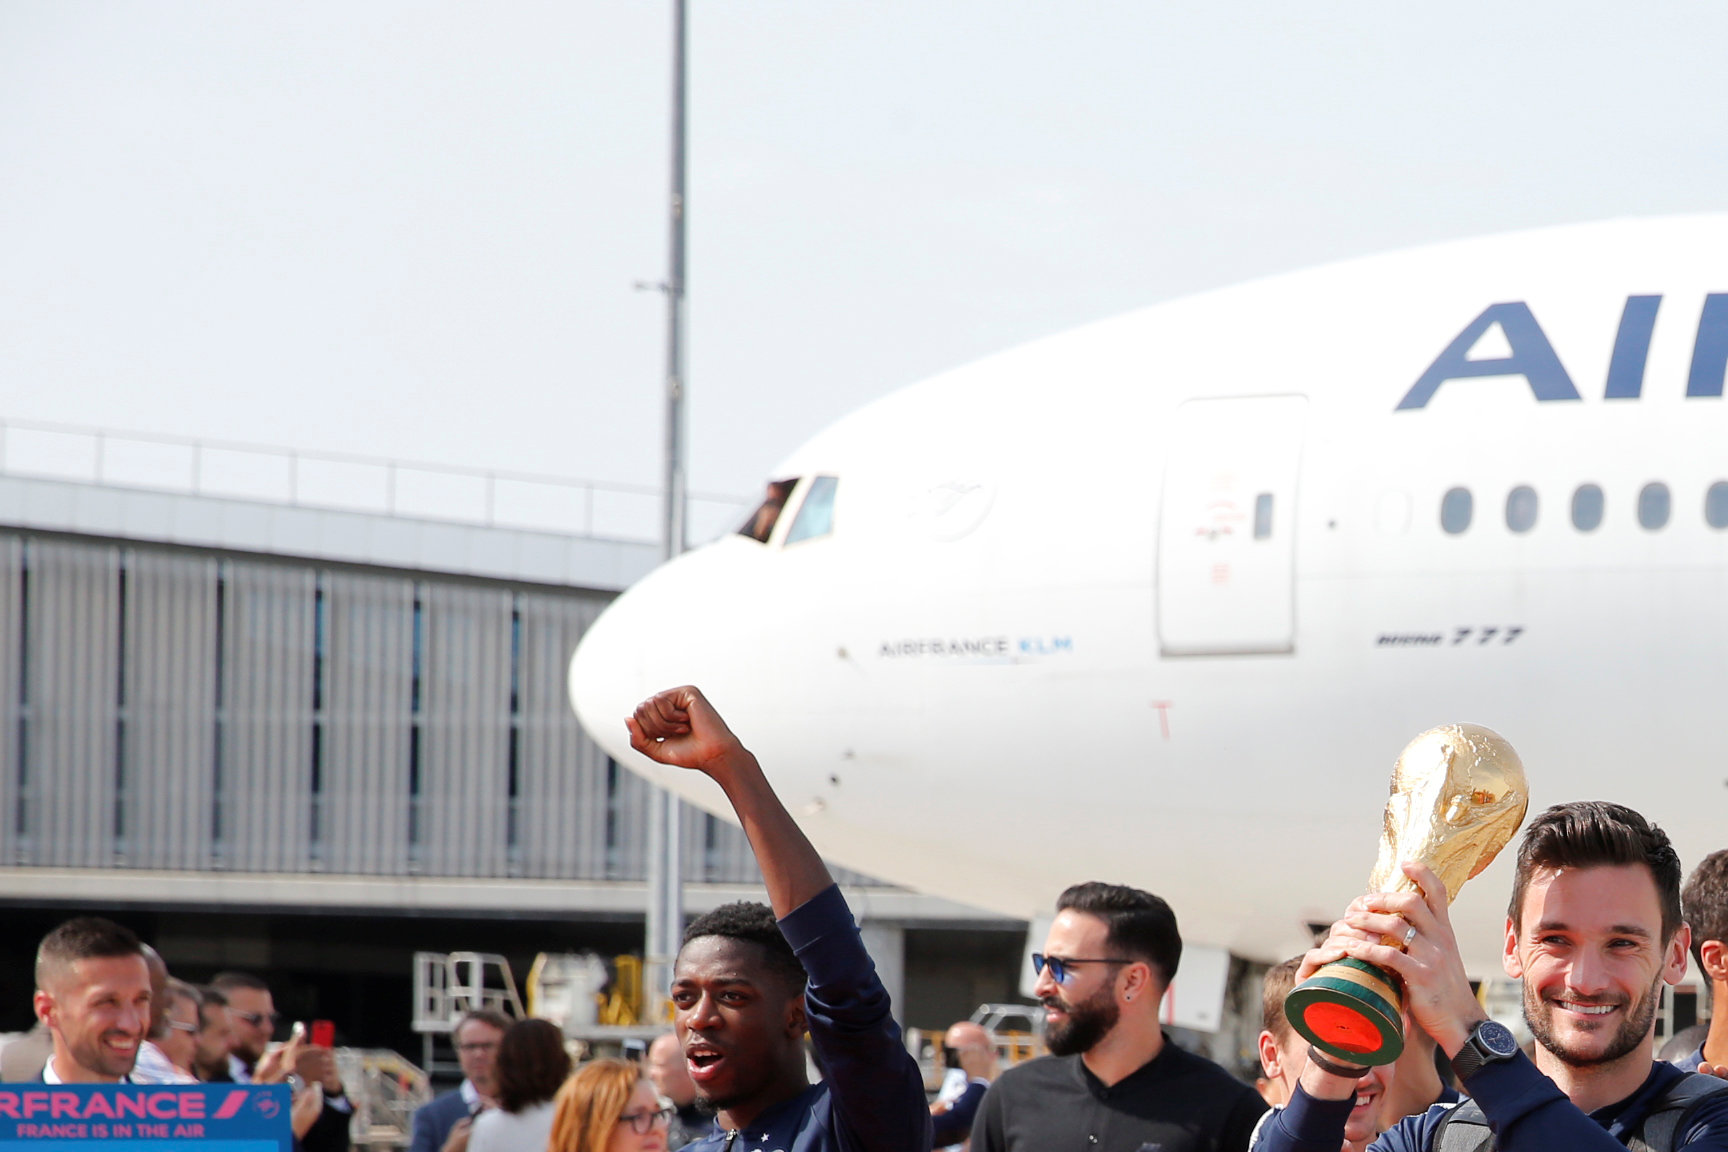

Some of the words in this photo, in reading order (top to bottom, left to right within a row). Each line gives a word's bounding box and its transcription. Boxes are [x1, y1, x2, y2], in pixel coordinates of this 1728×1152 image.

[1452, 624, 1524, 645] 777
[880, 637, 1008, 658] AIRFRANCE
[1017, 634, 1072, 655] KLM
[17, 1124, 88, 1138] FRANCE
[93, 1124, 109, 1138] IS
[114, 1124, 132, 1138] IN
[137, 1124, 169, 1138] THE
[174, 1124, 205, 1138] AIR
